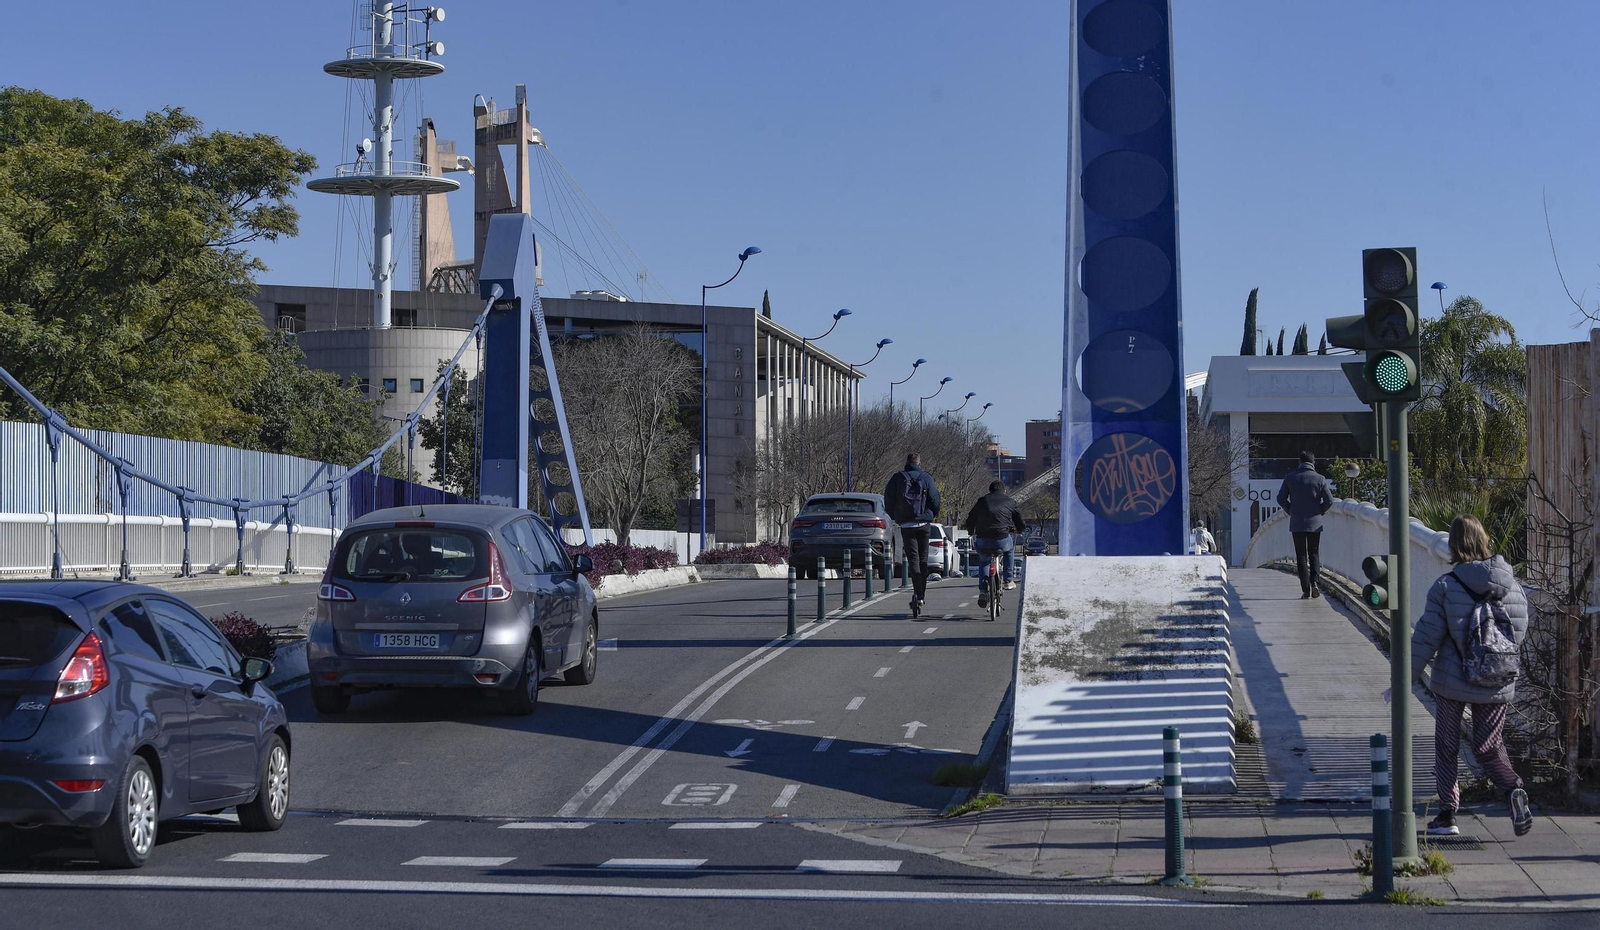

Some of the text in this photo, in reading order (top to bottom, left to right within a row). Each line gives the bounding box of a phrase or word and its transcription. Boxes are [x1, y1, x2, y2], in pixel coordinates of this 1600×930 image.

[733, 347, 743, 436] CANAL
[383, 635, 437, 647] 1358 HCG
